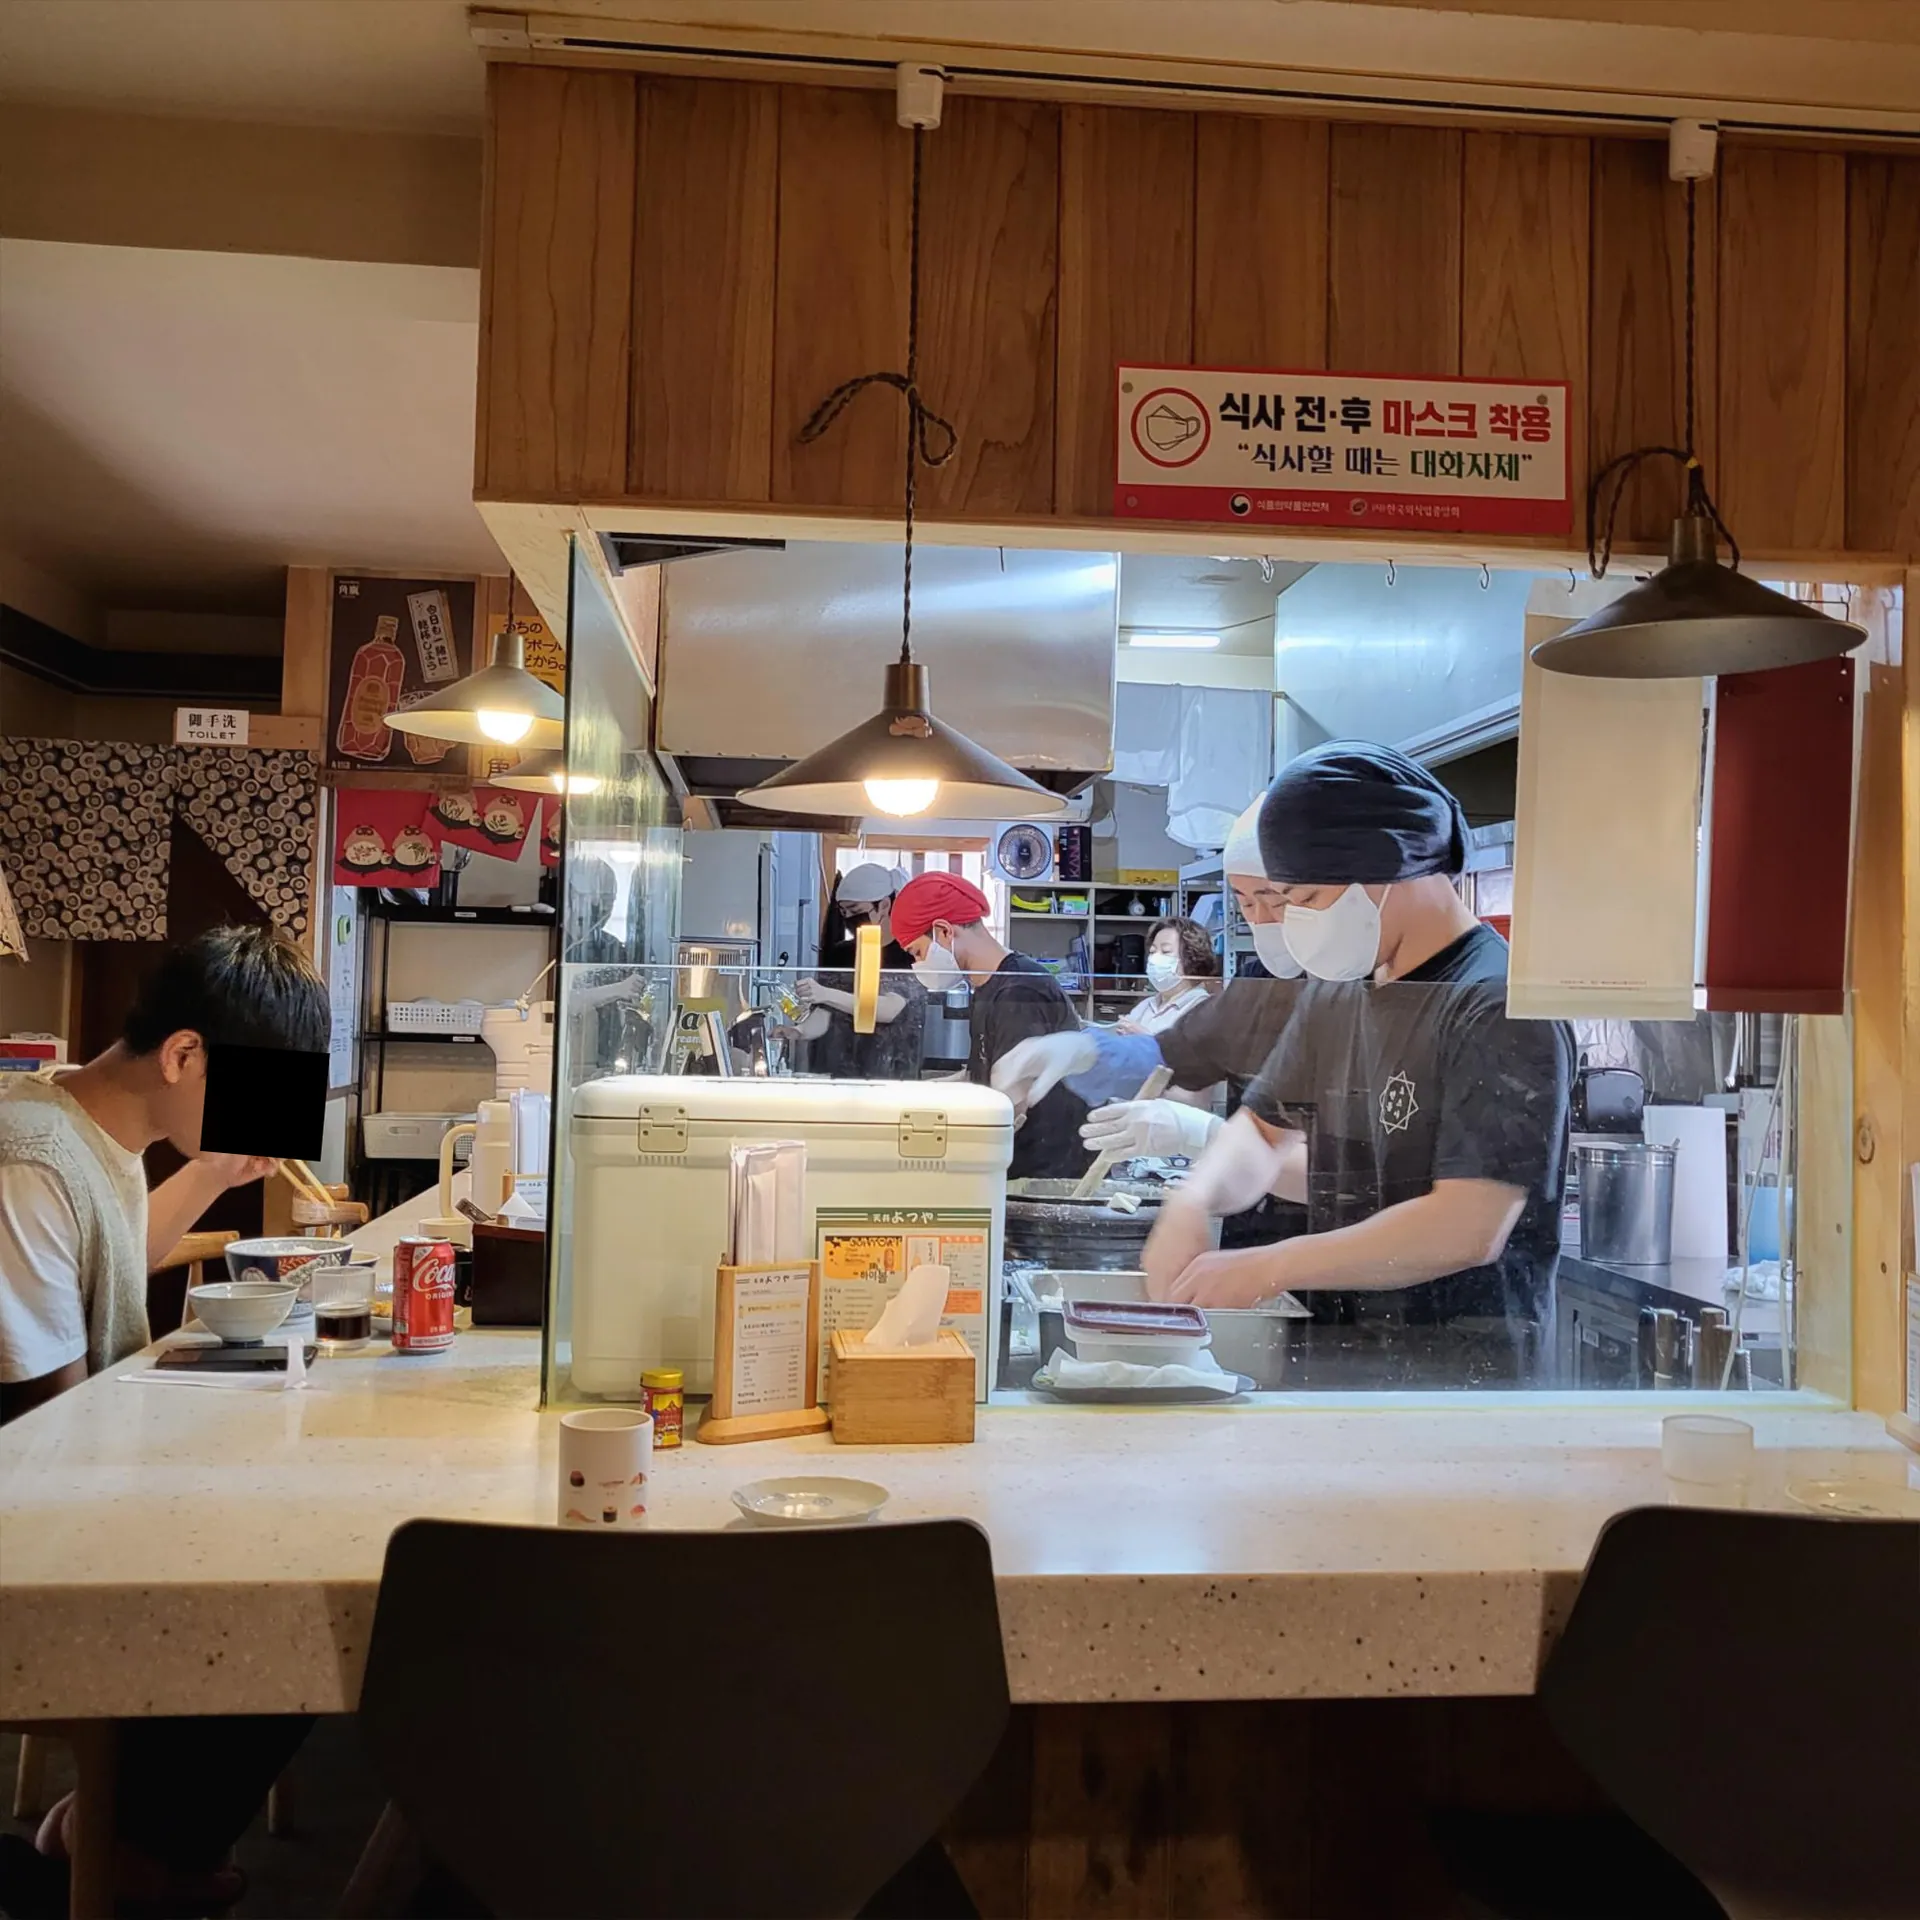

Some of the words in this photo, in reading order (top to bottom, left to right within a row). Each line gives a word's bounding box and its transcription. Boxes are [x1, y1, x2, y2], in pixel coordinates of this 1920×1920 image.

[1219, 392, 1285, 431] 식사
[1295, 396, 1371, 434] 전·후
[1383, 400, 1477, 438] 마스크
[1489, 403, 1551, 442] 착용
[1238, 443, 1334, 474] “식사할
[1346, 447, 1400, 476] 때는
[1411, 450, 1532, 481] 대화자제”
[189, 713, 237, 728] 御手洗
[188, 730, 237, 740] TOILET
